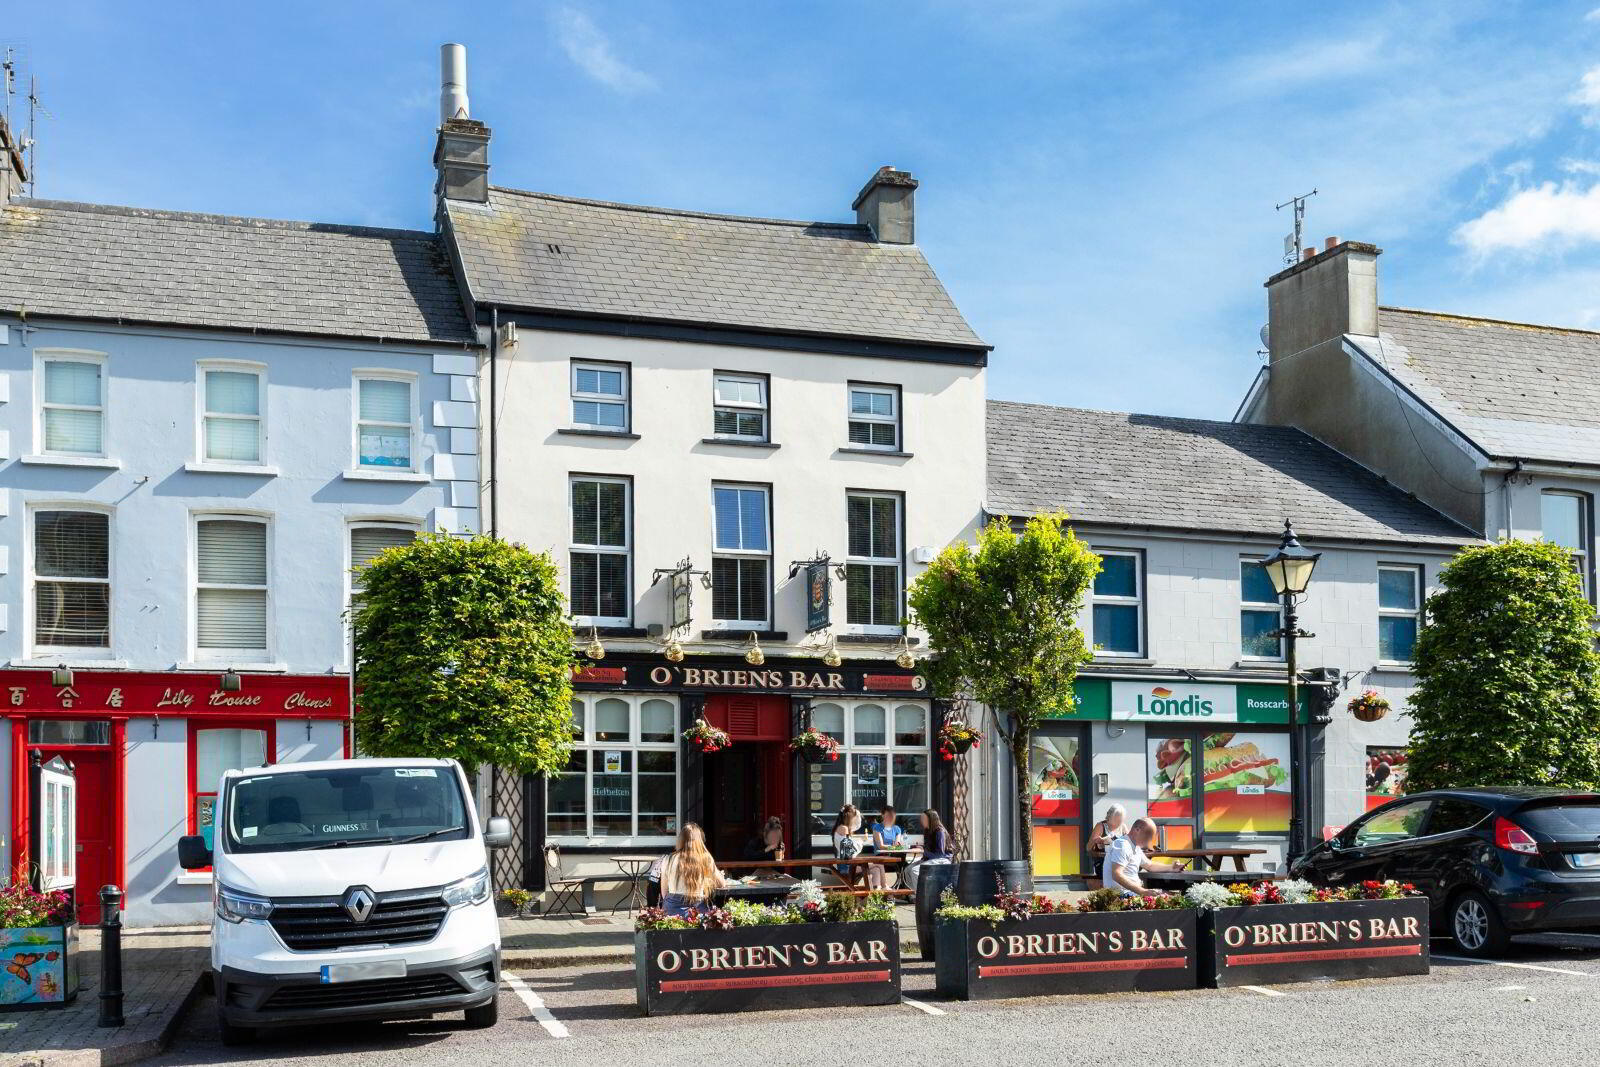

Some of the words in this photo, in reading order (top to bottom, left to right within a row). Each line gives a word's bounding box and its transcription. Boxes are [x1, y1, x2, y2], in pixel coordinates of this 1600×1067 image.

[789, 671, 845, 689] BAR
[914, 677, 923, 689] 3
[157, 687, 194, 708] Lily
[208, 690, 262, 706] House
[1137, 694, 1213, 717] Londis
[1247, 698, 1303, 713] Rosscarby
[1047, 791, 1067, 799] Londis
[322, 823, 359, 833] GUINNESS
[1368, 917, 1420, 940] BAR
[1130, 928, 1186, 952] BAR
[826, 940, 890, 965] BAR
